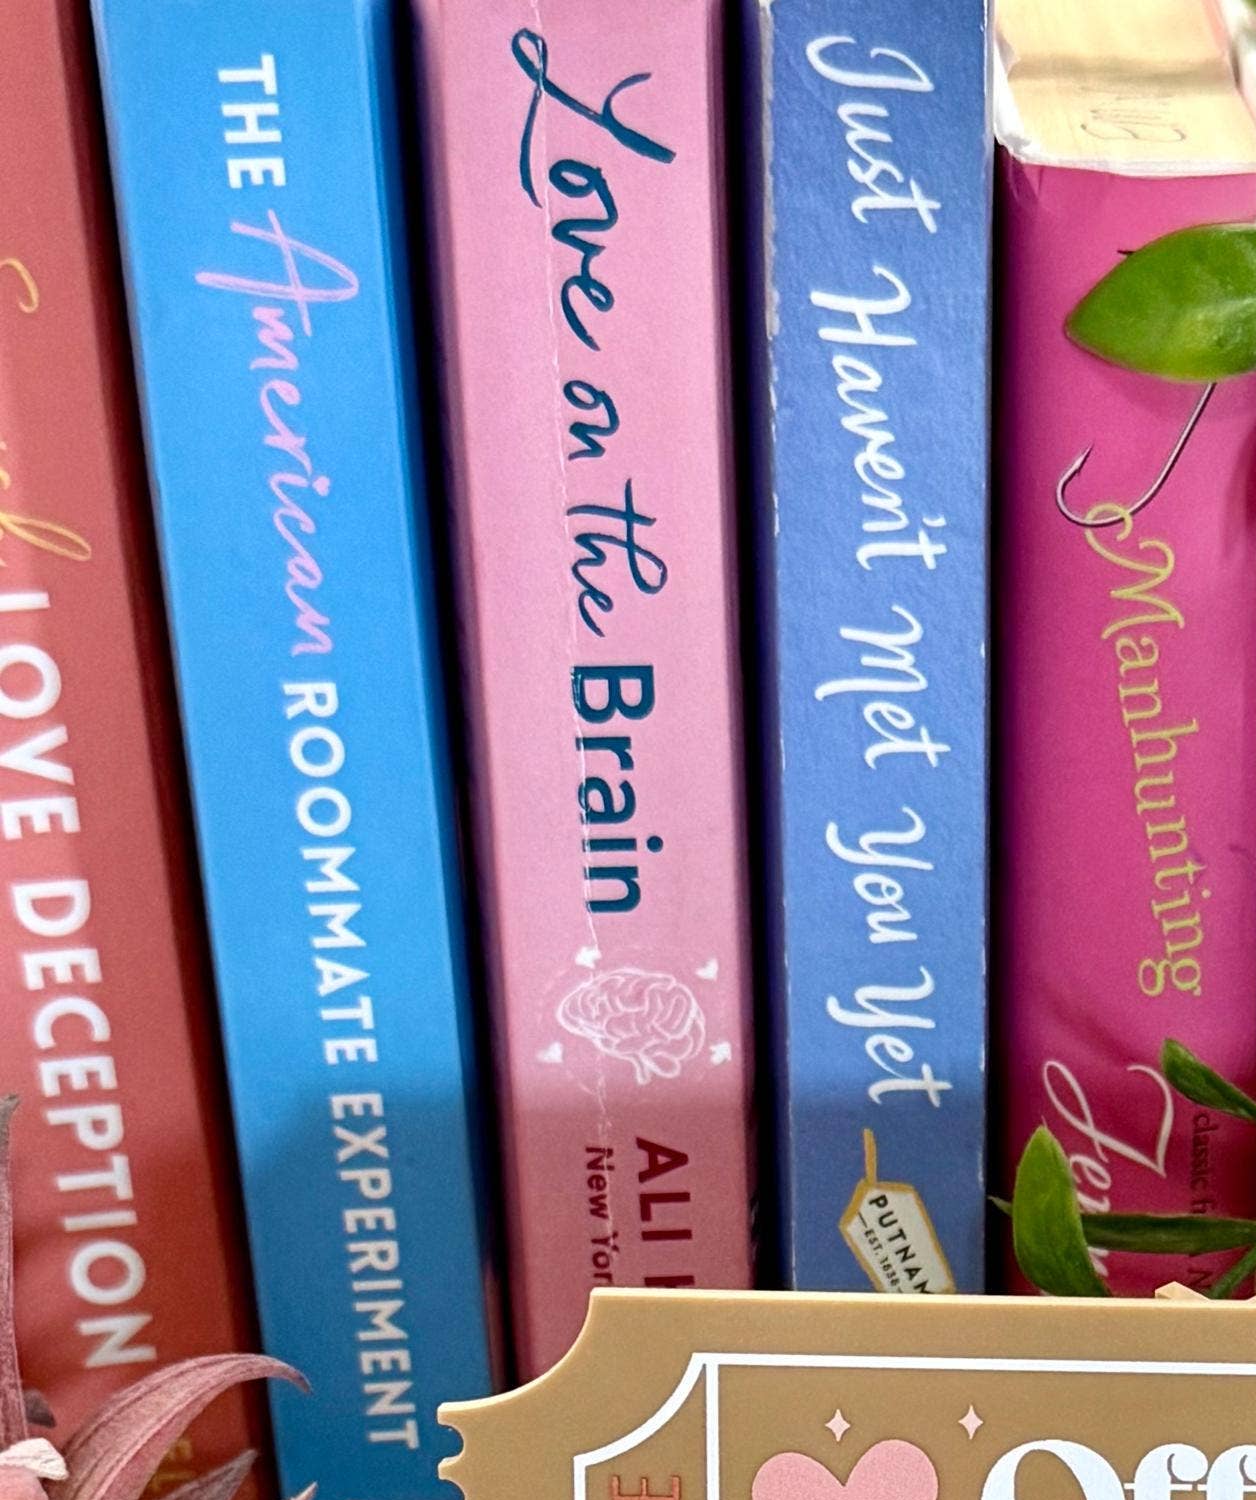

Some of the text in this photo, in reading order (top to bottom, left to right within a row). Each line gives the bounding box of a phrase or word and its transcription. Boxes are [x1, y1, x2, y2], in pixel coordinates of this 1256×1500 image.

[511, 27, 677, 915] Love on the Brain
[805, 35, 954, 1109] Just Haven't Met You Yet
[194, 53, 421, 1450] THE American ROOMMATE EXPERIMENT
[1083, 502, 1213, 998] Manhunting
[11, 878, 157, 1369] DECEPTION
[585, 1146, 621, 1285] New Yor
[635, 1136, 694, 1242] ALI
